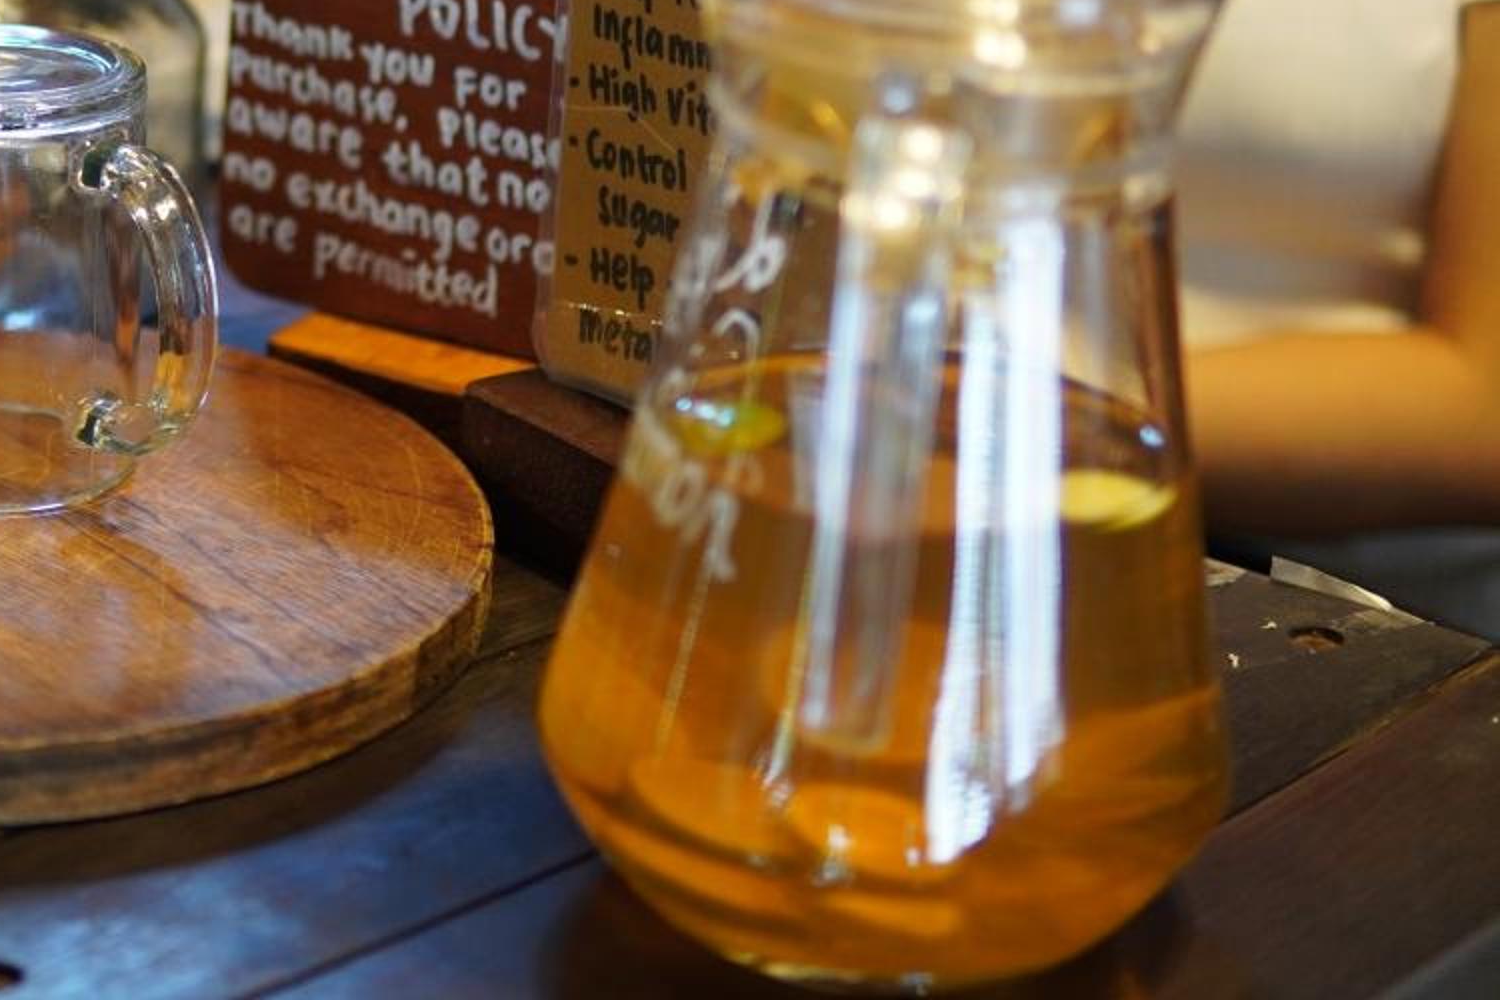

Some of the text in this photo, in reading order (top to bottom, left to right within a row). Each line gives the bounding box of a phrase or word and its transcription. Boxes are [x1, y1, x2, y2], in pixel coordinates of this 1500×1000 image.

[233, 0, 353, 60] Thank
[589, 65, 656, 121] High
[383, 139, 488, 205] that
[586, 128, 686, 191] Control
[223, 152, 275, 192] no
[286, 172, 480, 263] exchange
[228, 205, 497, 318] are permitted
[591, 249, 654, 311] Help
